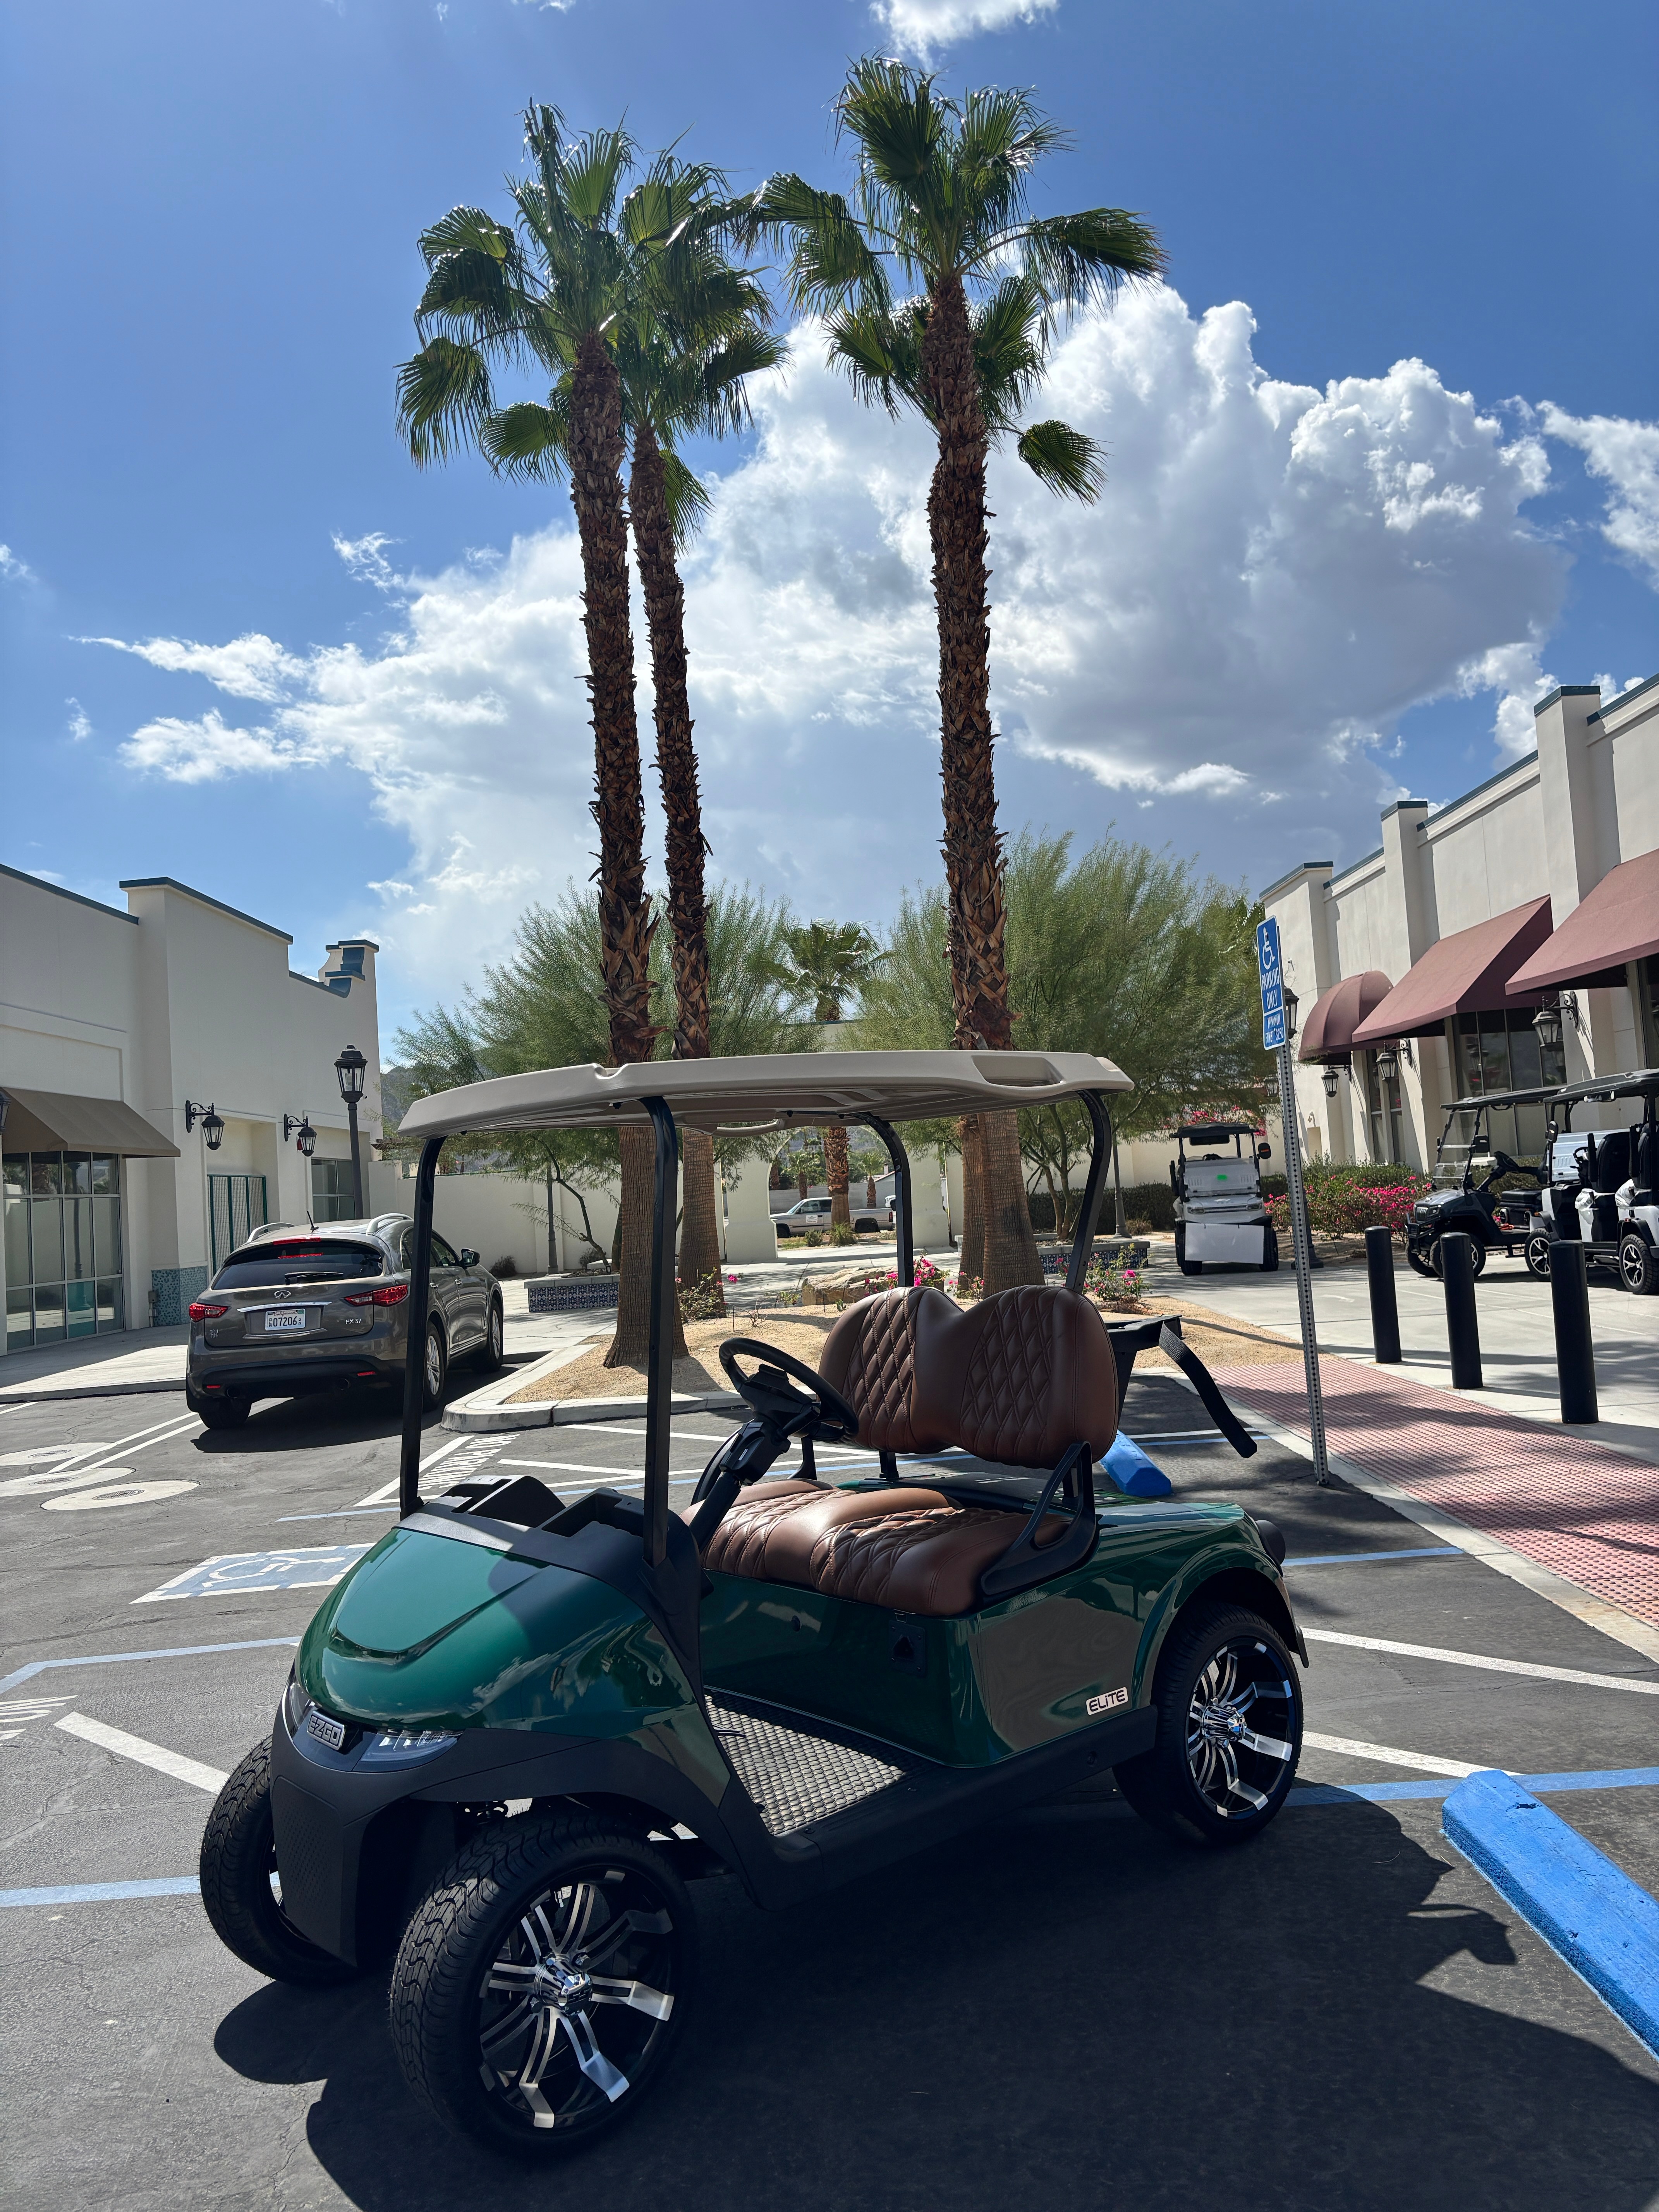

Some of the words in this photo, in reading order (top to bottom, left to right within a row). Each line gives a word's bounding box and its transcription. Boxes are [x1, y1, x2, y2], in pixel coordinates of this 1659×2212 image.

[1261, 967, 1279, 991] PARKING
[1266, 989, 1278, 1010] ONLY
[273, 1316, 297, 1327] 07206
[465, 1434, 520, 1449] NO
[417, 1448, 502, 1490] PARKING
[308, 1716, 341, 1745] EZGO
